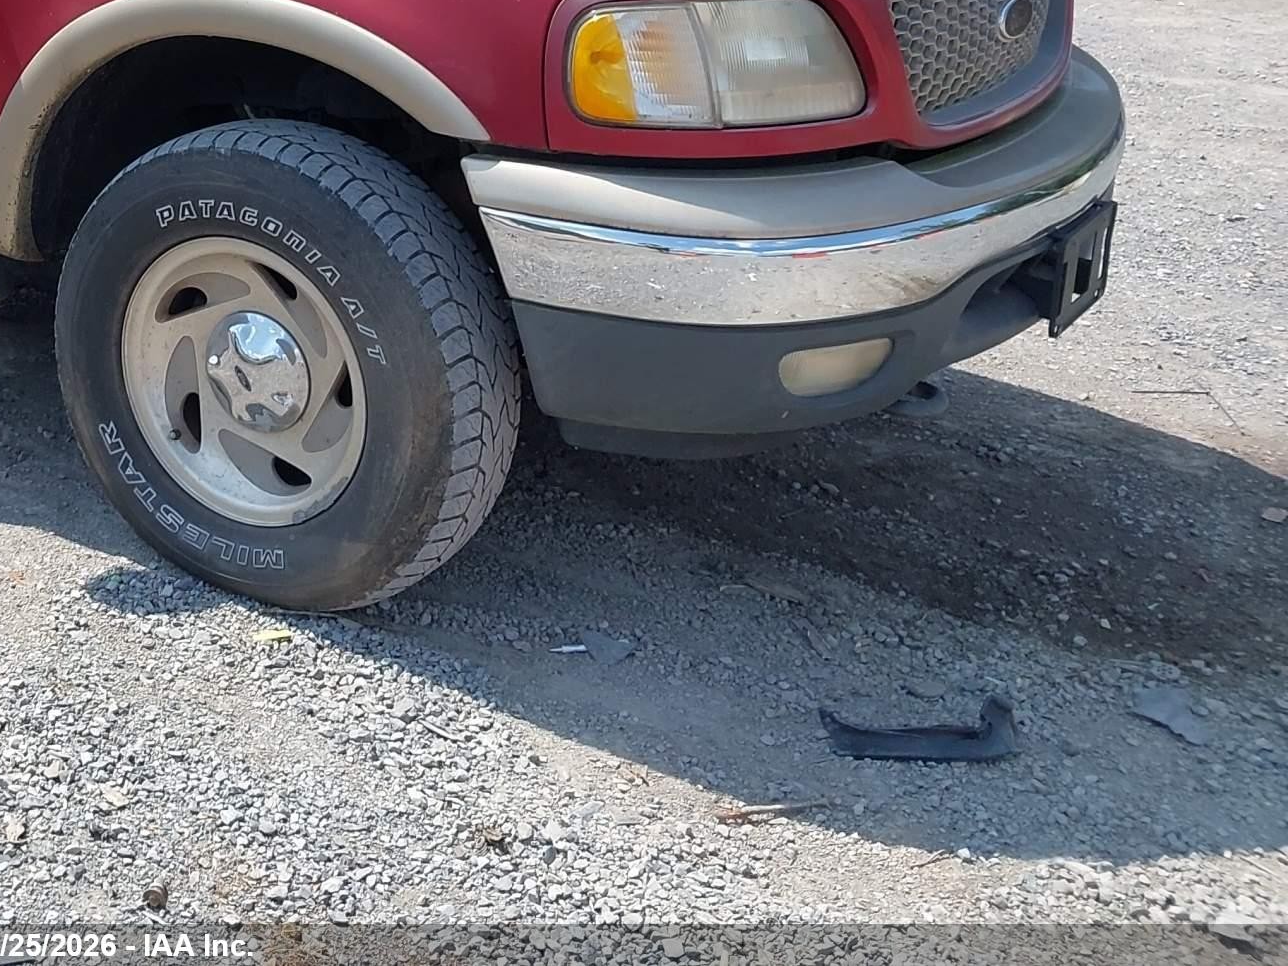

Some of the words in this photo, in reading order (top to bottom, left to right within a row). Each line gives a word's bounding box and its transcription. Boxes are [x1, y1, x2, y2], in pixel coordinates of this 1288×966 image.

[154, 198, 341, 287] PATAGONIA
[340, 296, 389, 367] A/T
[97, 421, 285, 571] MILESTAR
